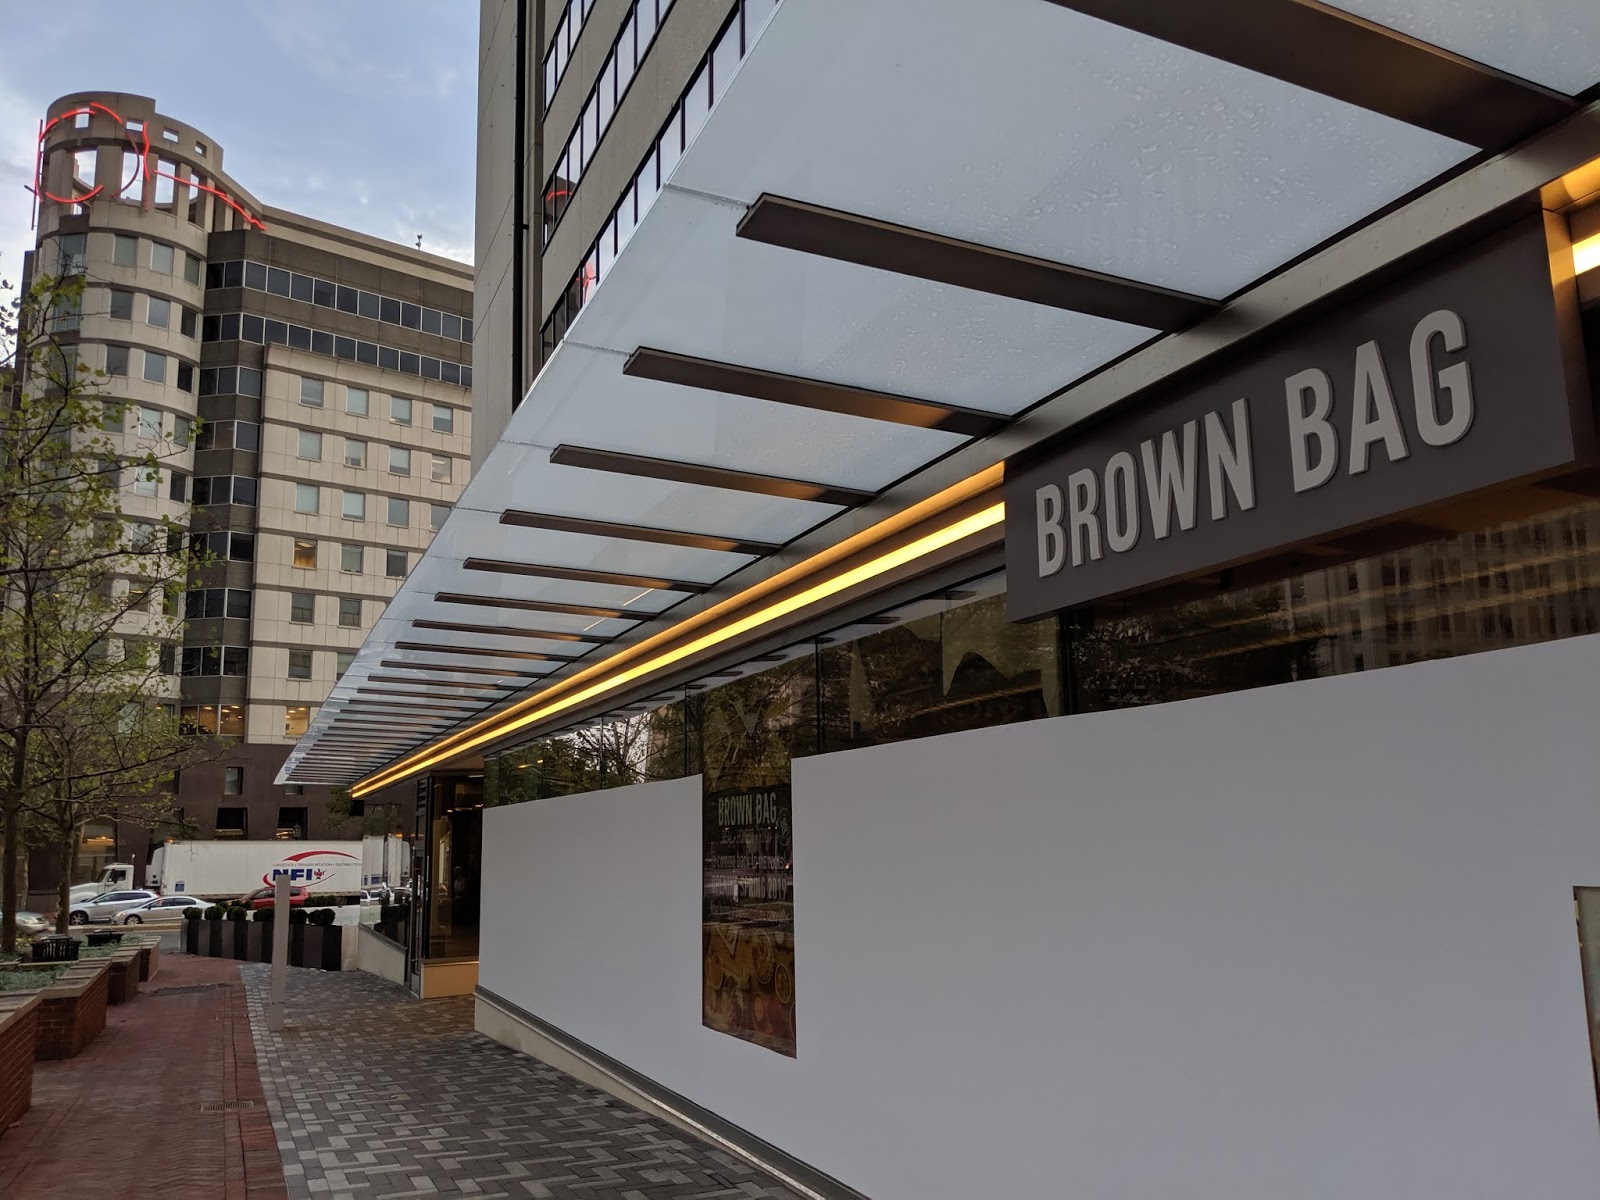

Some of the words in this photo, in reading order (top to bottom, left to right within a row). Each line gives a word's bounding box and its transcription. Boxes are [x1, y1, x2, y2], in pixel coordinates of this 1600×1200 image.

[1035, 397, 1257, 578] BROWN
[1283, 309, 1476, 494] BAG
[718, 794, 752, 826] BROWN
[755, 792, 777, 825] BAG
[272, 868, 313, 881] NFI
[740, 876, 766, 899] SPRING
[767, 877, 787, 900] 2019
